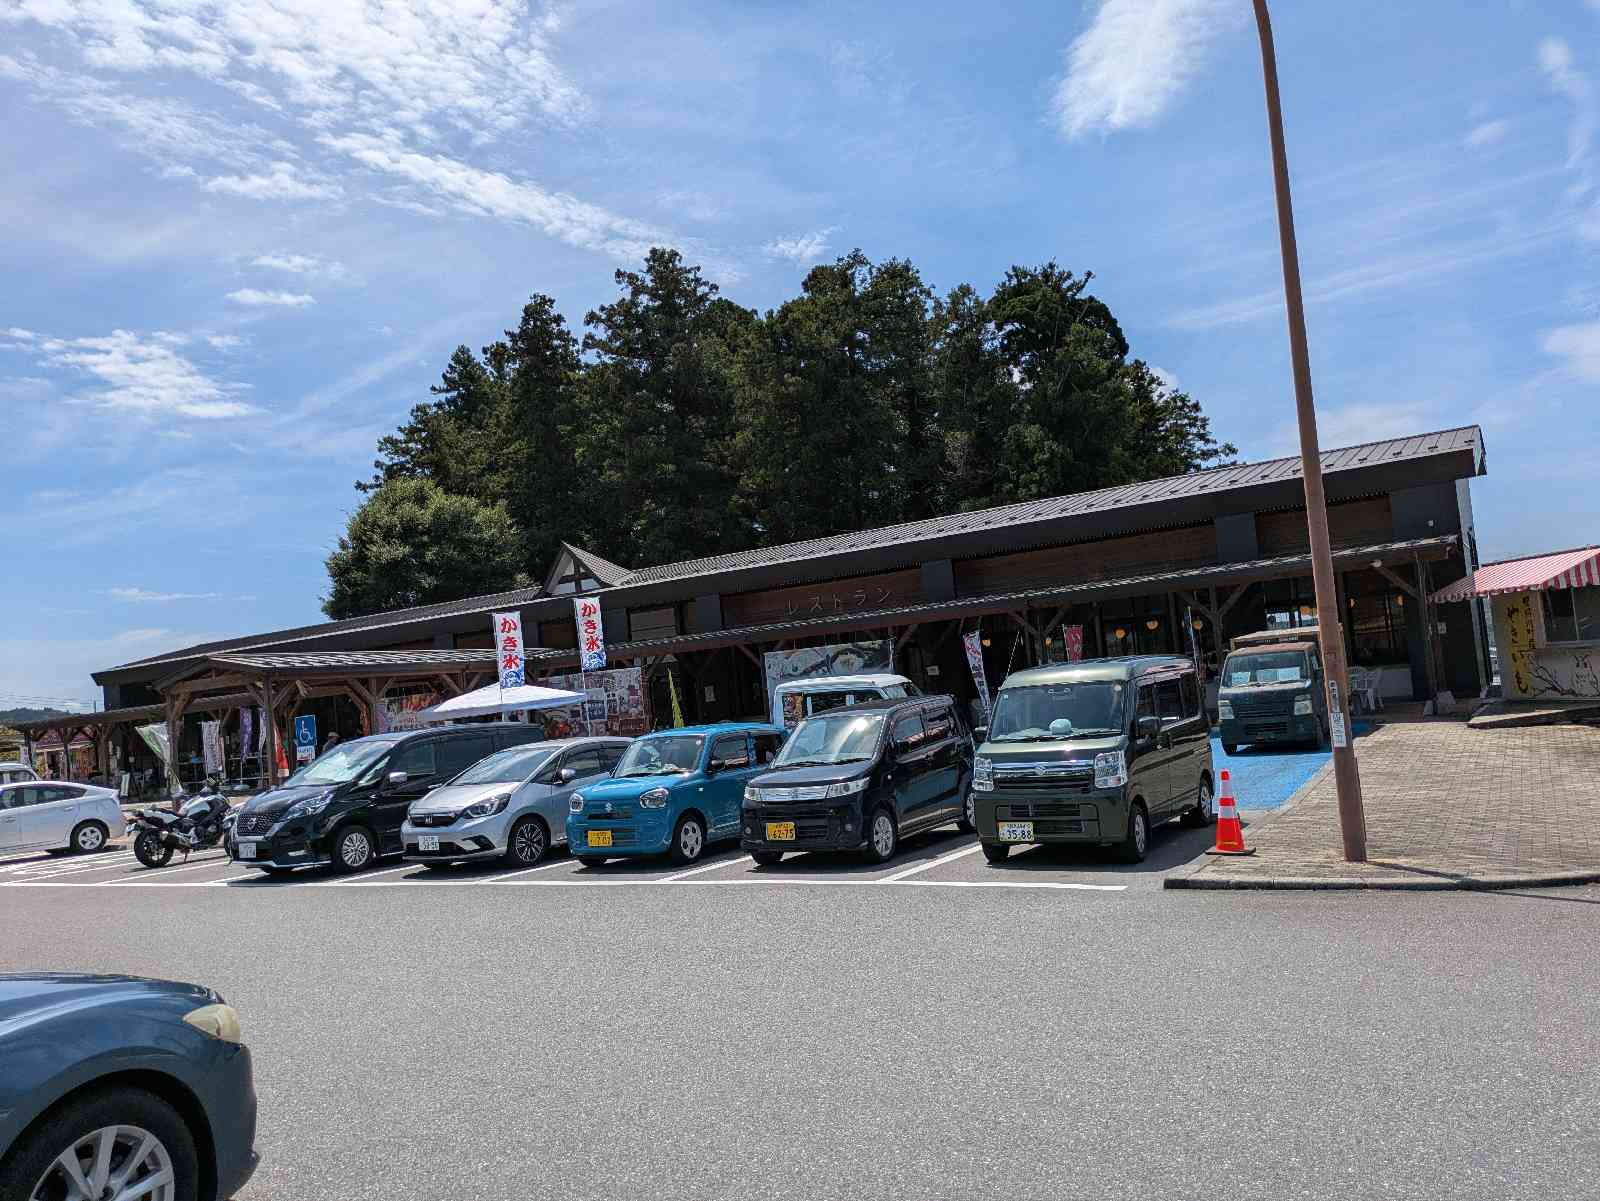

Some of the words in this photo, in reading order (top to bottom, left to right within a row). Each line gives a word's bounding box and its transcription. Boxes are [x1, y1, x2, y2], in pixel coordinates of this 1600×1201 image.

[788, 587, 891, 616] レストラン
[500, 617, 520, 670] かき氷
[582, 602, 600, 652] かき氷
